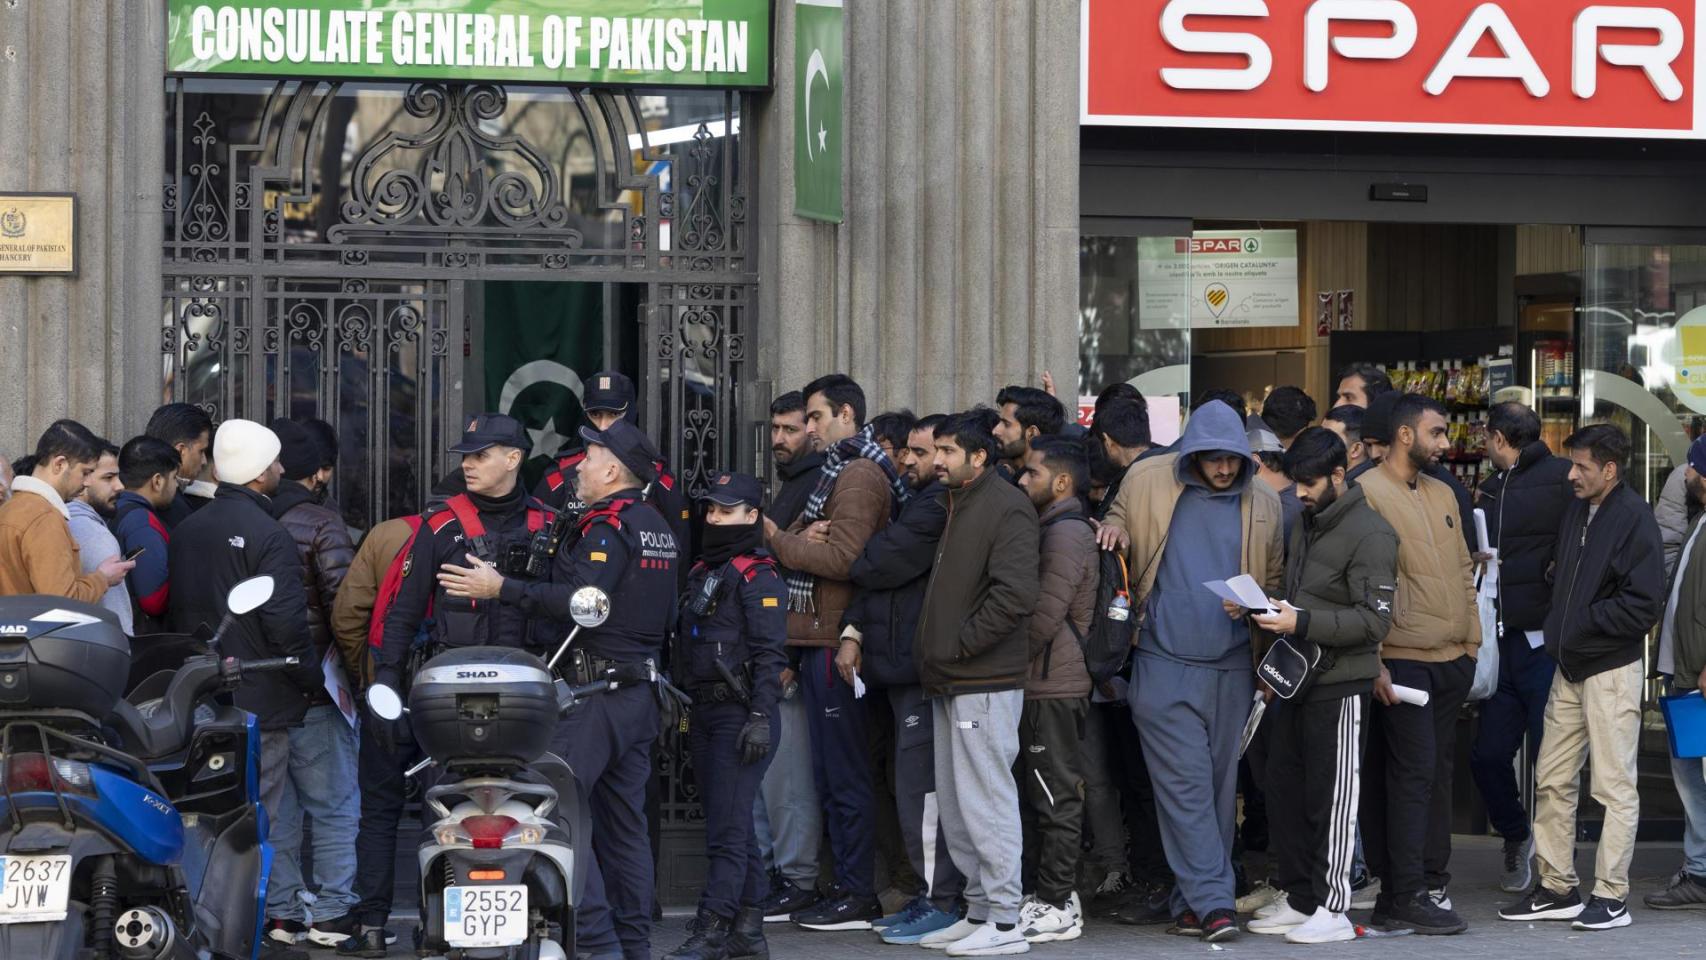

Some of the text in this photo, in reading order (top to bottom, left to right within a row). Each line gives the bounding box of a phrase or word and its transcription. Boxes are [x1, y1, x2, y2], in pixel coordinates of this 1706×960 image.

[192, 6, 748, 73] CONSULATE GENERAL OF PAKISTAN
[1159, 0, 1684, 101] SPAR
[0, 244, 66, 252] ENERAL OF PAKISTAN
[1191, 240, 1240, 251] SPAR
[640, 530, 676, 549] POLICIA
[456, 671, 498, 679] SHAD
[1264, 664, 1284, 683] adidas
[8, 860, 67, 882] 2637
[7, 885, 48, 908] JVW
[464, 890, 522, 912] 2552
[464, 915, 507, 936] GYP
